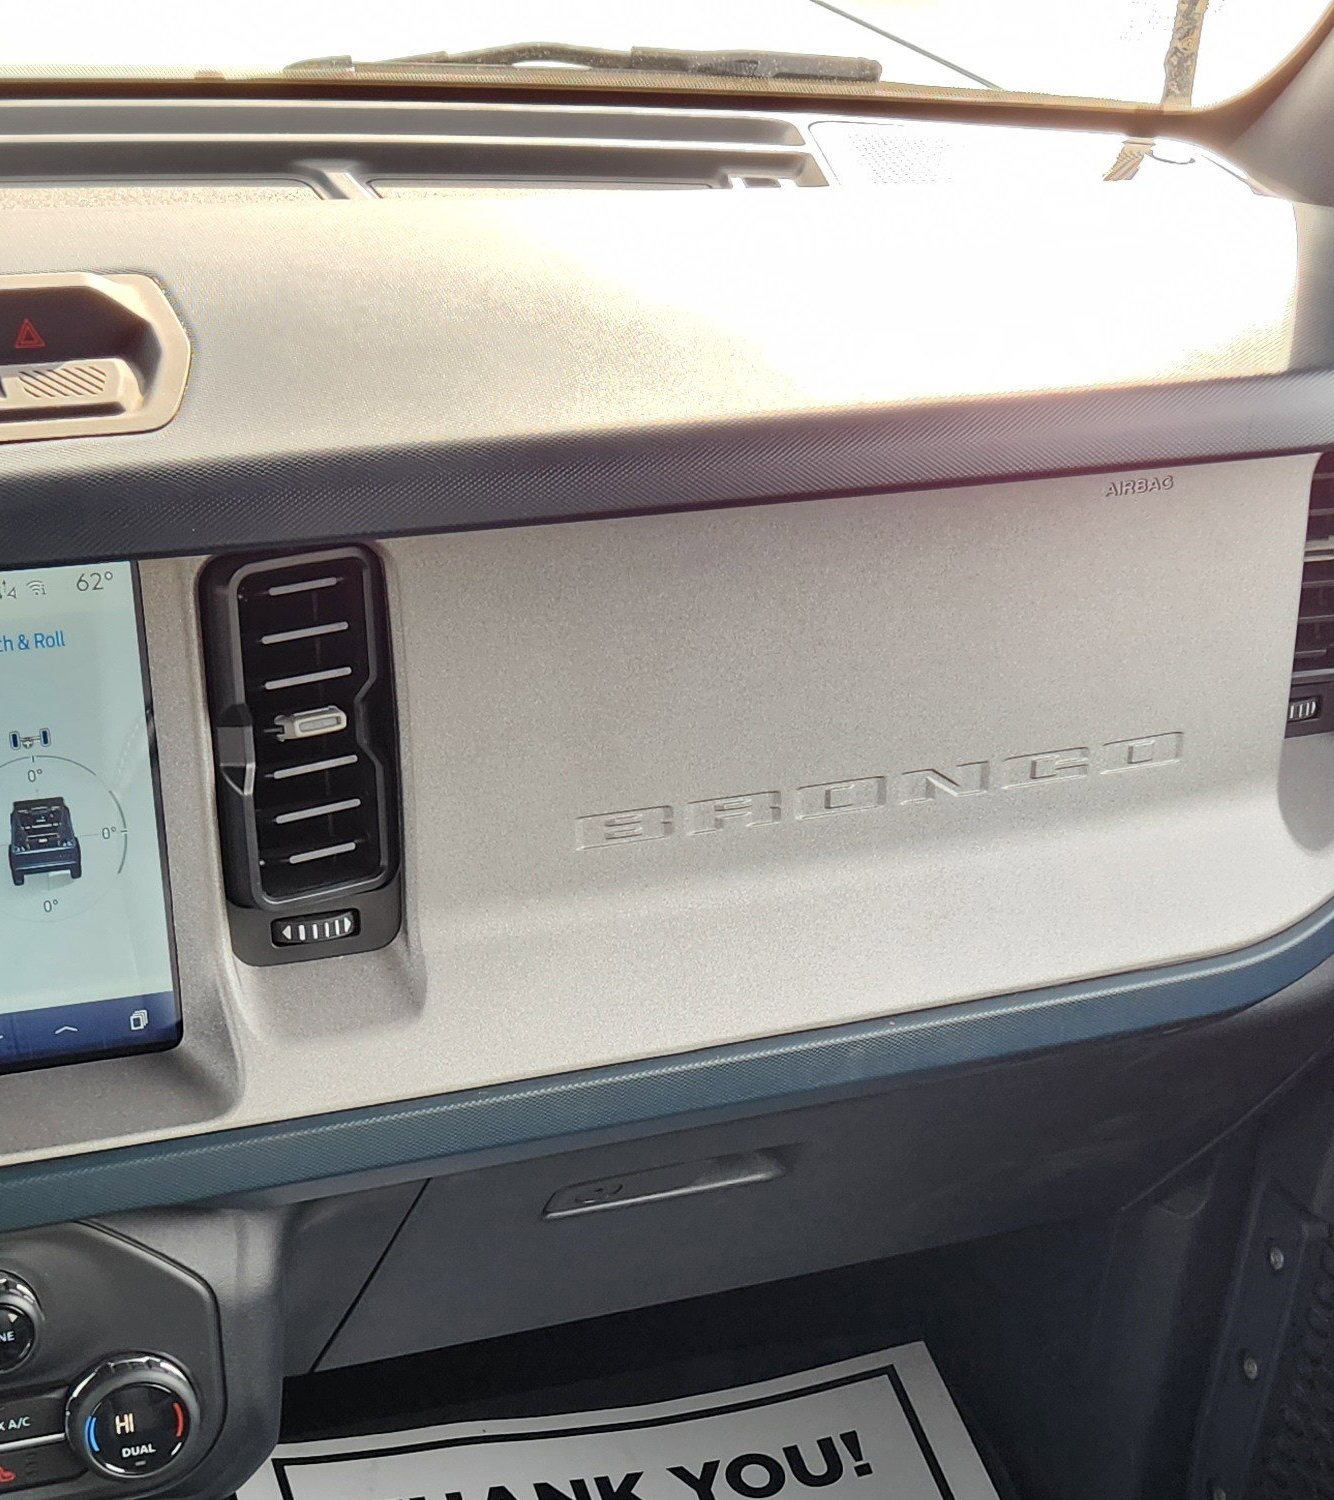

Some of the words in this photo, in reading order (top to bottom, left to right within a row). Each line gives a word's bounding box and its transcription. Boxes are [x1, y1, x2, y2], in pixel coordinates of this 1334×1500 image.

[1105, 474, 1174, 498] AIRBAG
[76, 571, 114, 592] 62°
[17, 635, 31, 651] &
[34, 630, 66, 650] Roll
[575, 730, 1185, 852] BRONCO
[7, 1416, 31, 1430] A/C
[115, 1413, 135, 1435] HI
[121, 1442, 156, 1458] DUAL
